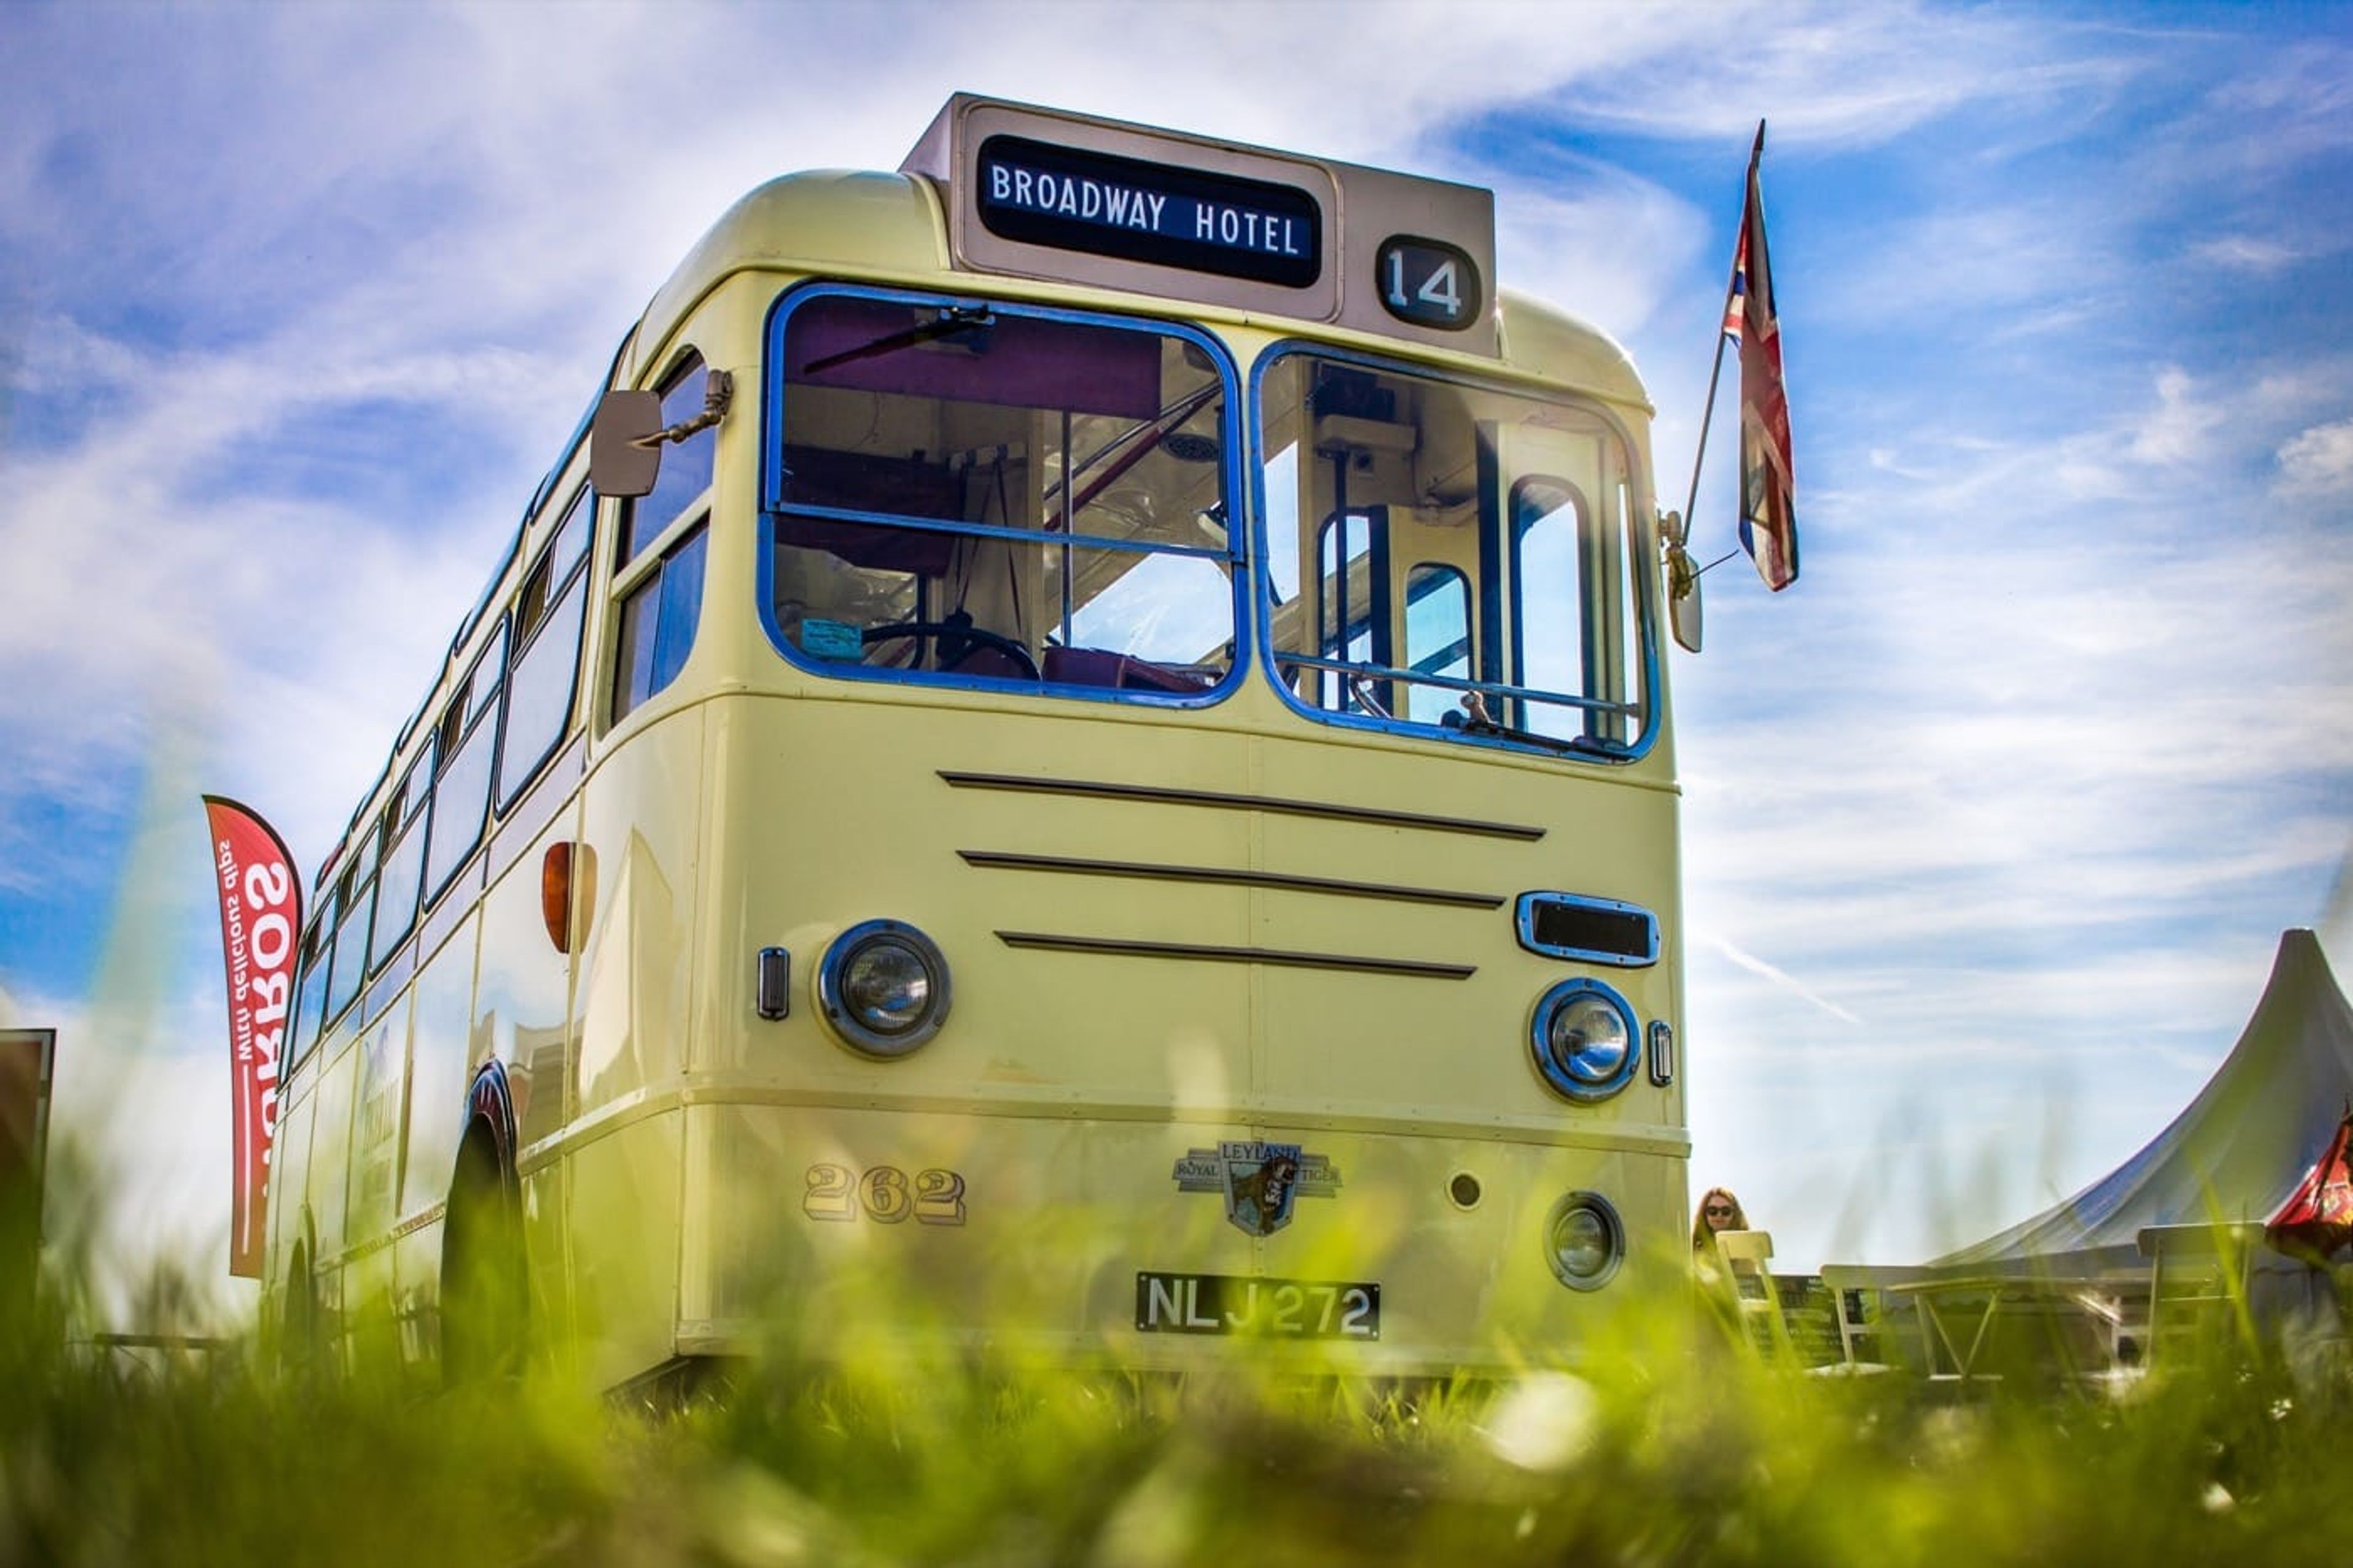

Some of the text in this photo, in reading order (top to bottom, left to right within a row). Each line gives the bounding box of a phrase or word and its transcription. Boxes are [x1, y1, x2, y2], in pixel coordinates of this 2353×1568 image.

[991, 164, 1300, 255] BROADWAY HOTEL
[1386, 249, 1461, 316] 14
[1177, 1162, 1216, 1176] ROYAL
[1222, 1143, 1300, 1162] LEYLAND
[803, 1163, 966, 1227] 262
[1272, 1284, 1371, 1335] 272
